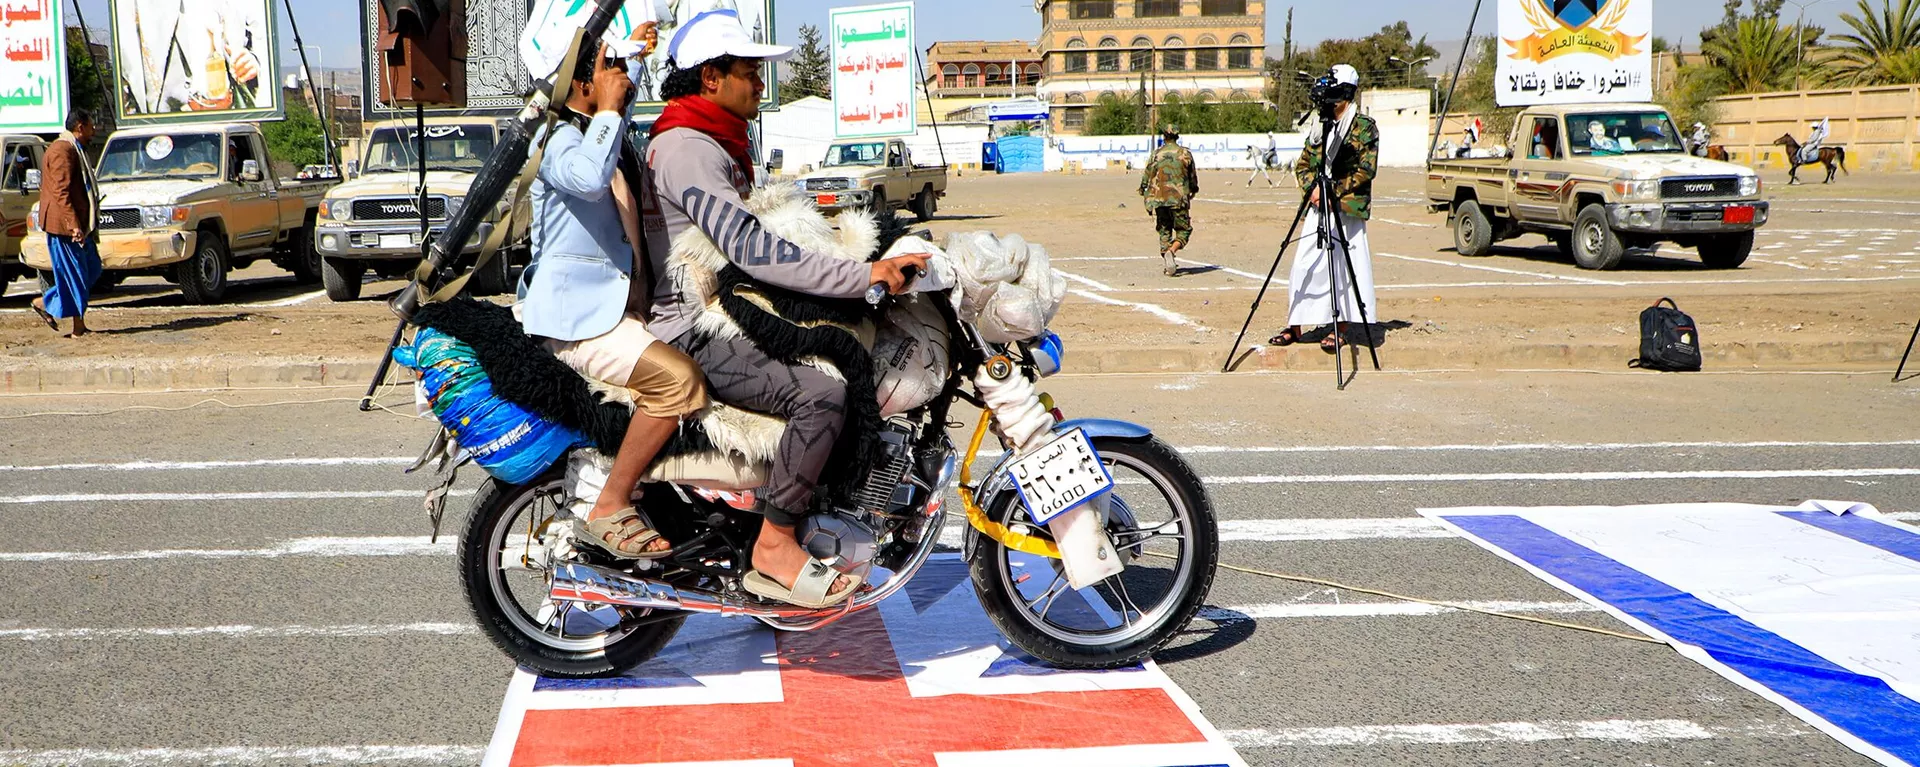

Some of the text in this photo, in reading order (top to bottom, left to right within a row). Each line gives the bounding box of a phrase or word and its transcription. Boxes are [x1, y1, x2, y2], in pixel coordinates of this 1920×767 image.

[0, 0, 49, 28] المو
[4, 37, 51, 62] اللعنة
[1537, 33, 1615, 58] التعبئة العامة
[875, 51, 908, 74] البضائع
[0, 71, 53, 115] النص
[868, 80, 874, 95] و
[1683, 183, 1715, 192] TOYOTA
[99, 215, 115, 224] OTA
[381, 205, 417, 213] TOYOTA
[1036, 443, 1067, 470] اليمن
[1071, 434, 1104, 485] YEMEN
[1041, 484, 1086, 515] 6600
